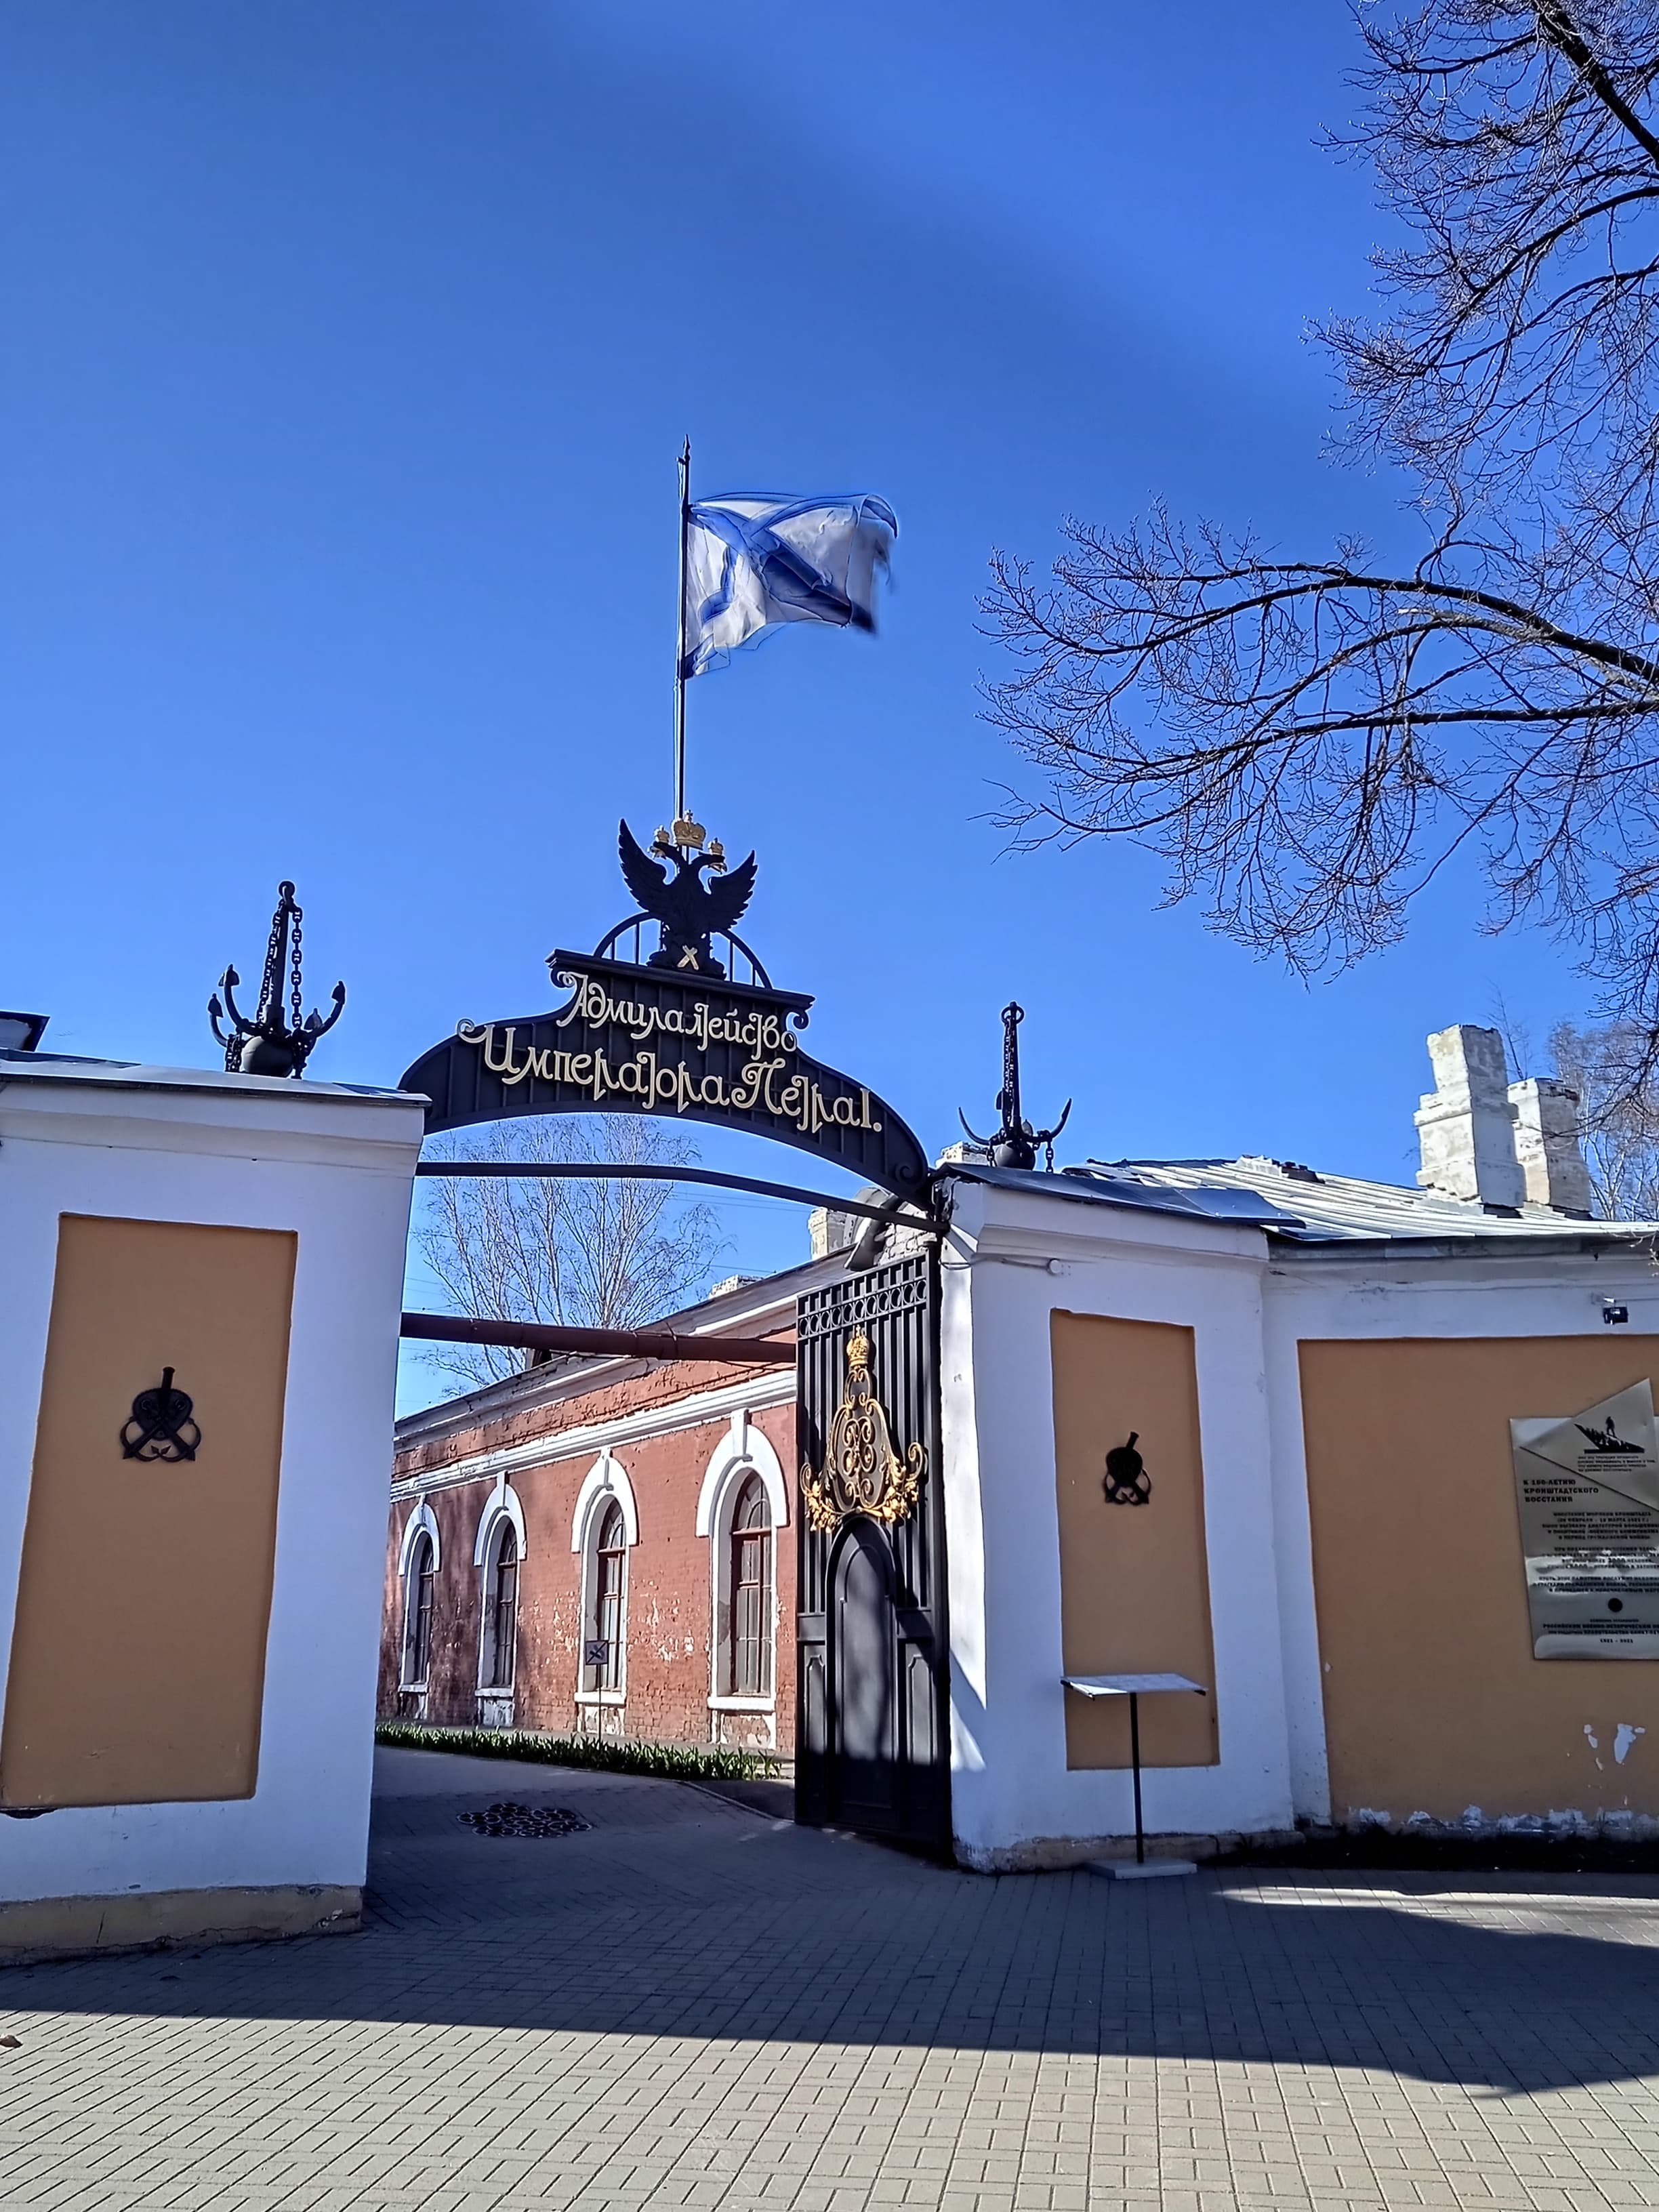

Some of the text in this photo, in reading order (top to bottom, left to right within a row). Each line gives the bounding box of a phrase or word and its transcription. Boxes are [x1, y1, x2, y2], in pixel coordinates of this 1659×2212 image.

[556, 972, 798, 1060] Адмиралтейство
[456, 1019, 731, 1113] Императора
[731, 1057, 861, 1134] Петра
